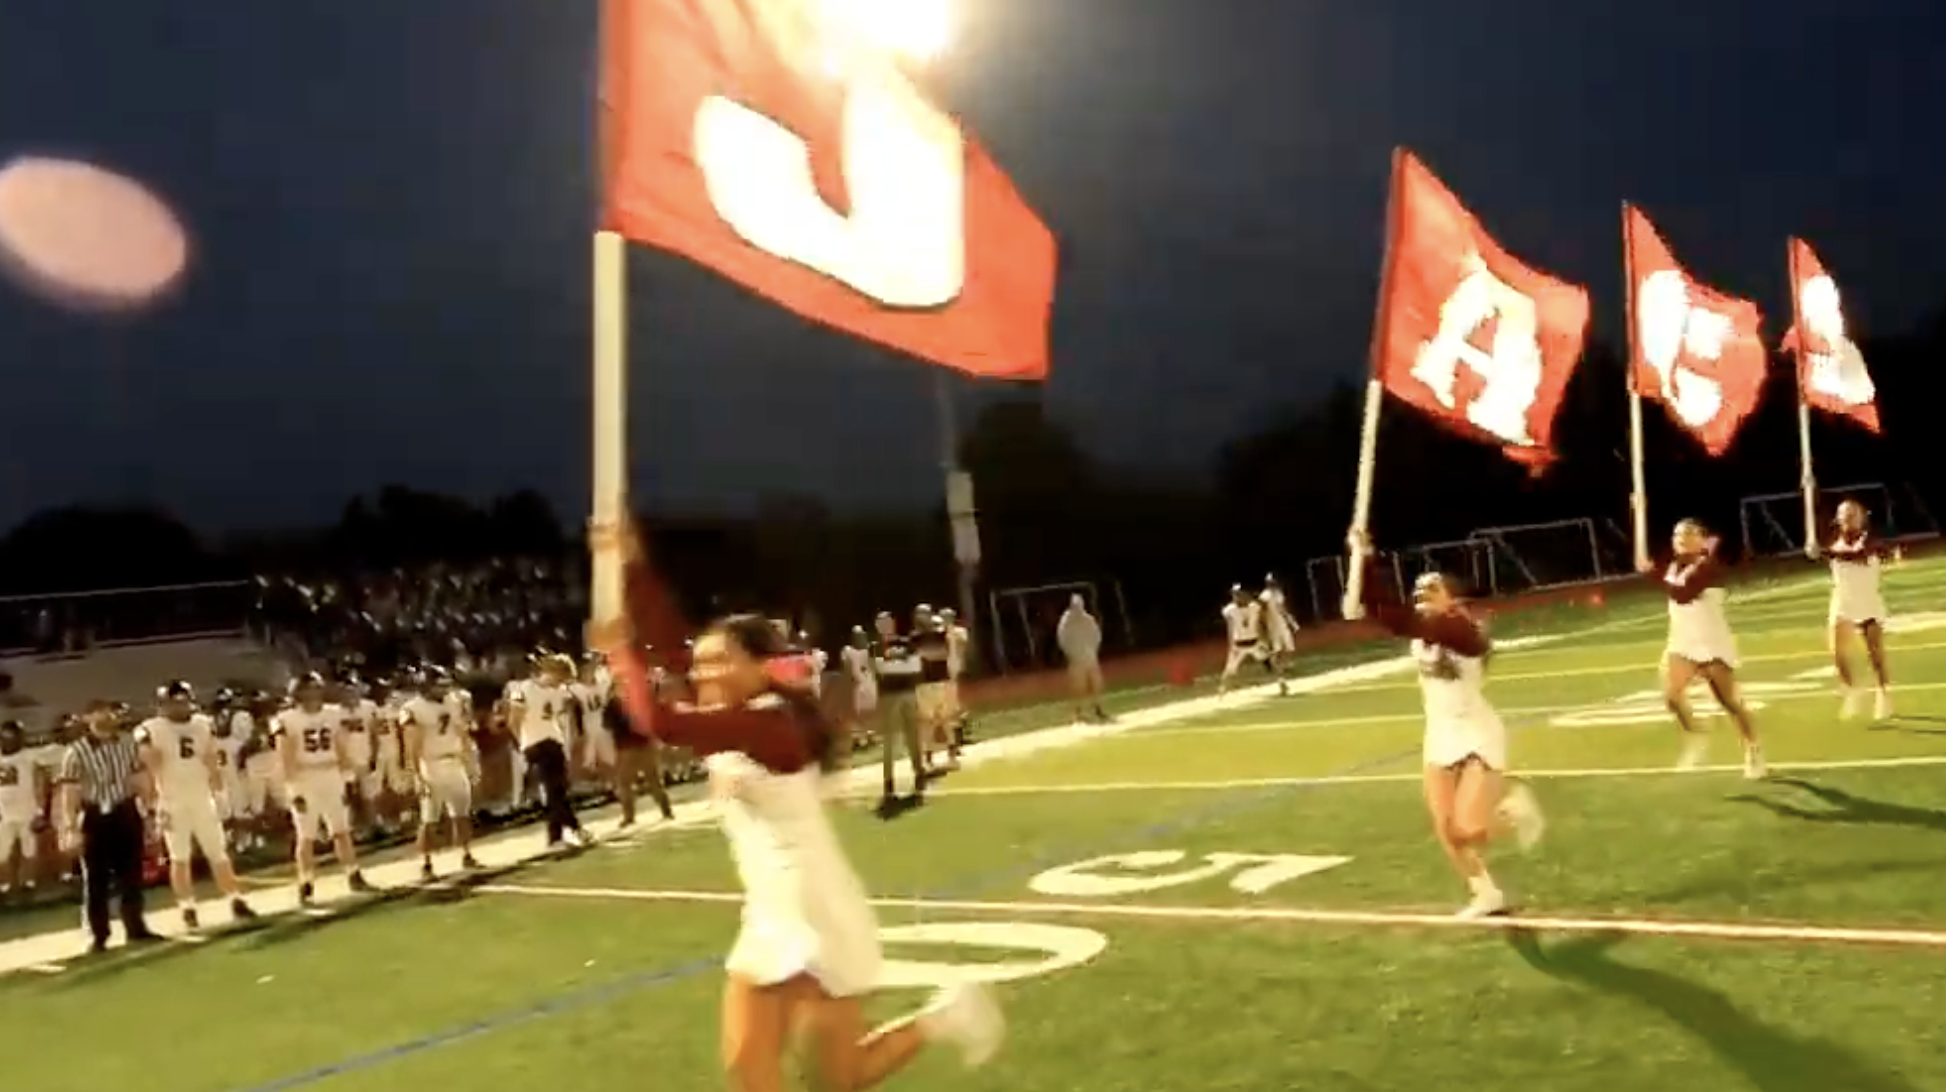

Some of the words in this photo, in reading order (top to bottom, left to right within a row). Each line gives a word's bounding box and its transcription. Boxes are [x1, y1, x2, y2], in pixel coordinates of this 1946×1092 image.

[694, 62, 966, 308] J
[1410, 256, 1543, 446] A
[180, 736, 195, 759] 6
[303, 726, 332, 753] 56
